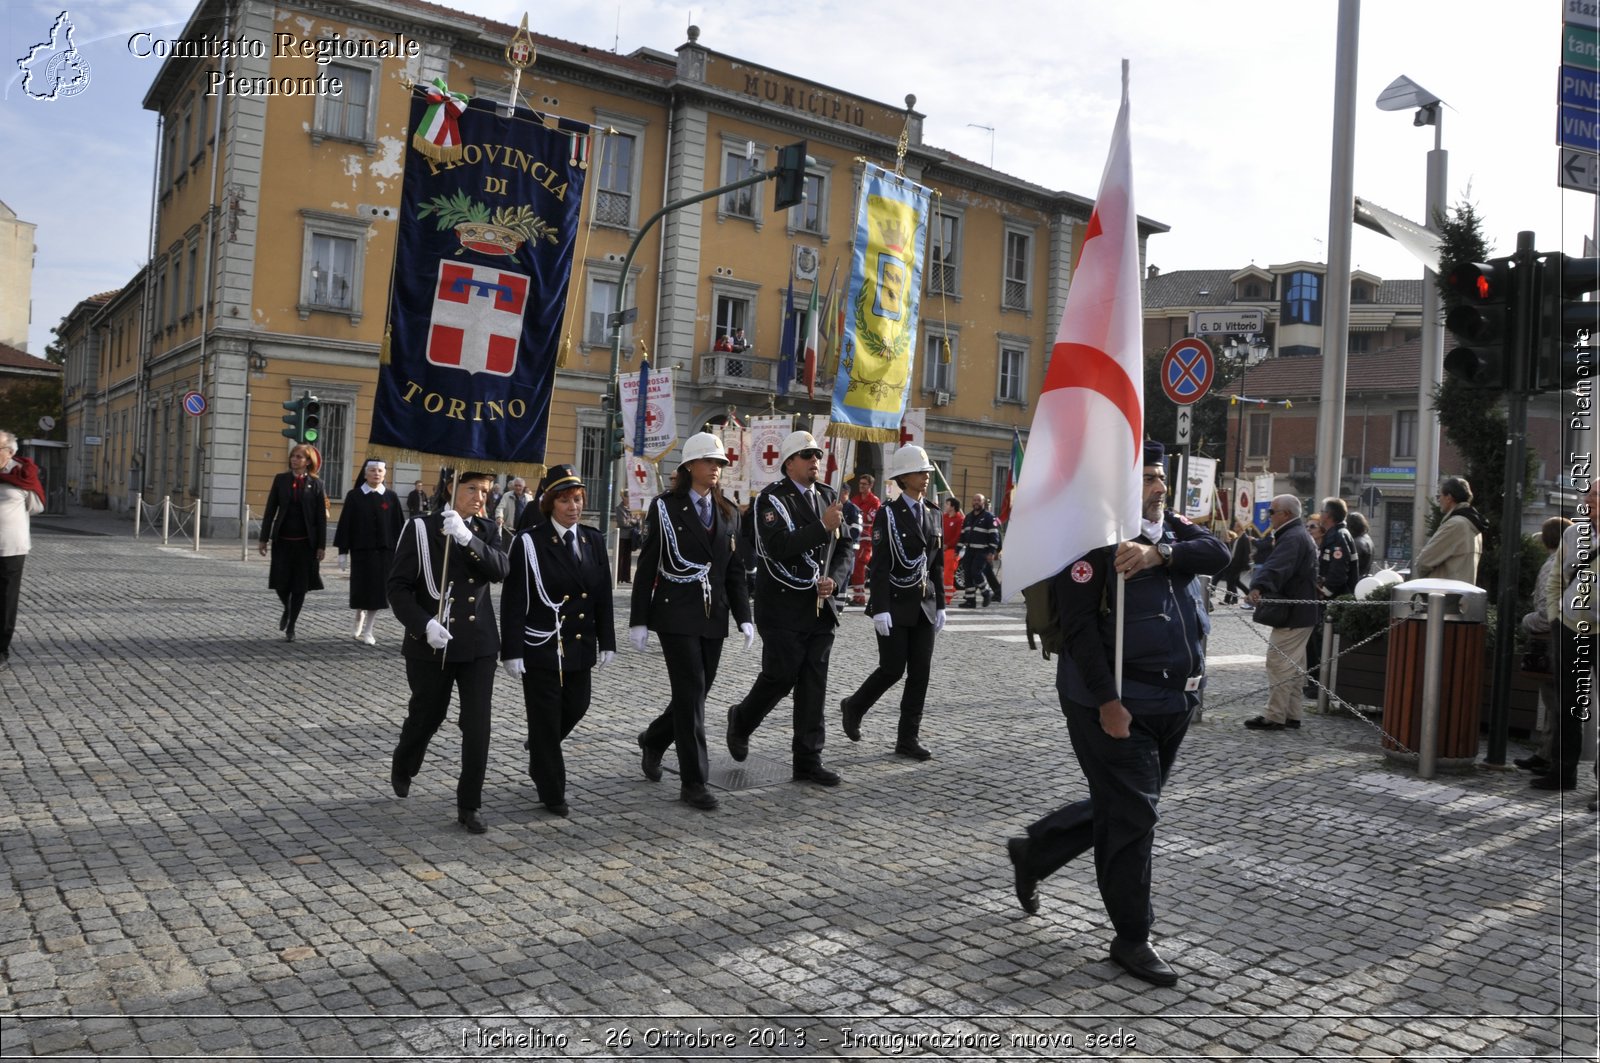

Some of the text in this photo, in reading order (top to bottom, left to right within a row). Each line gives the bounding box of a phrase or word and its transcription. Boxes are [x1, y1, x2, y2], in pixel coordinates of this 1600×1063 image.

[743, 74, 864, 127] MUNICIPIO
[484, 176, 508, 196] DI
[1200, 321, 1257, 331] G. Di Vittorio
[402, 380, 526, 421] TORINO
